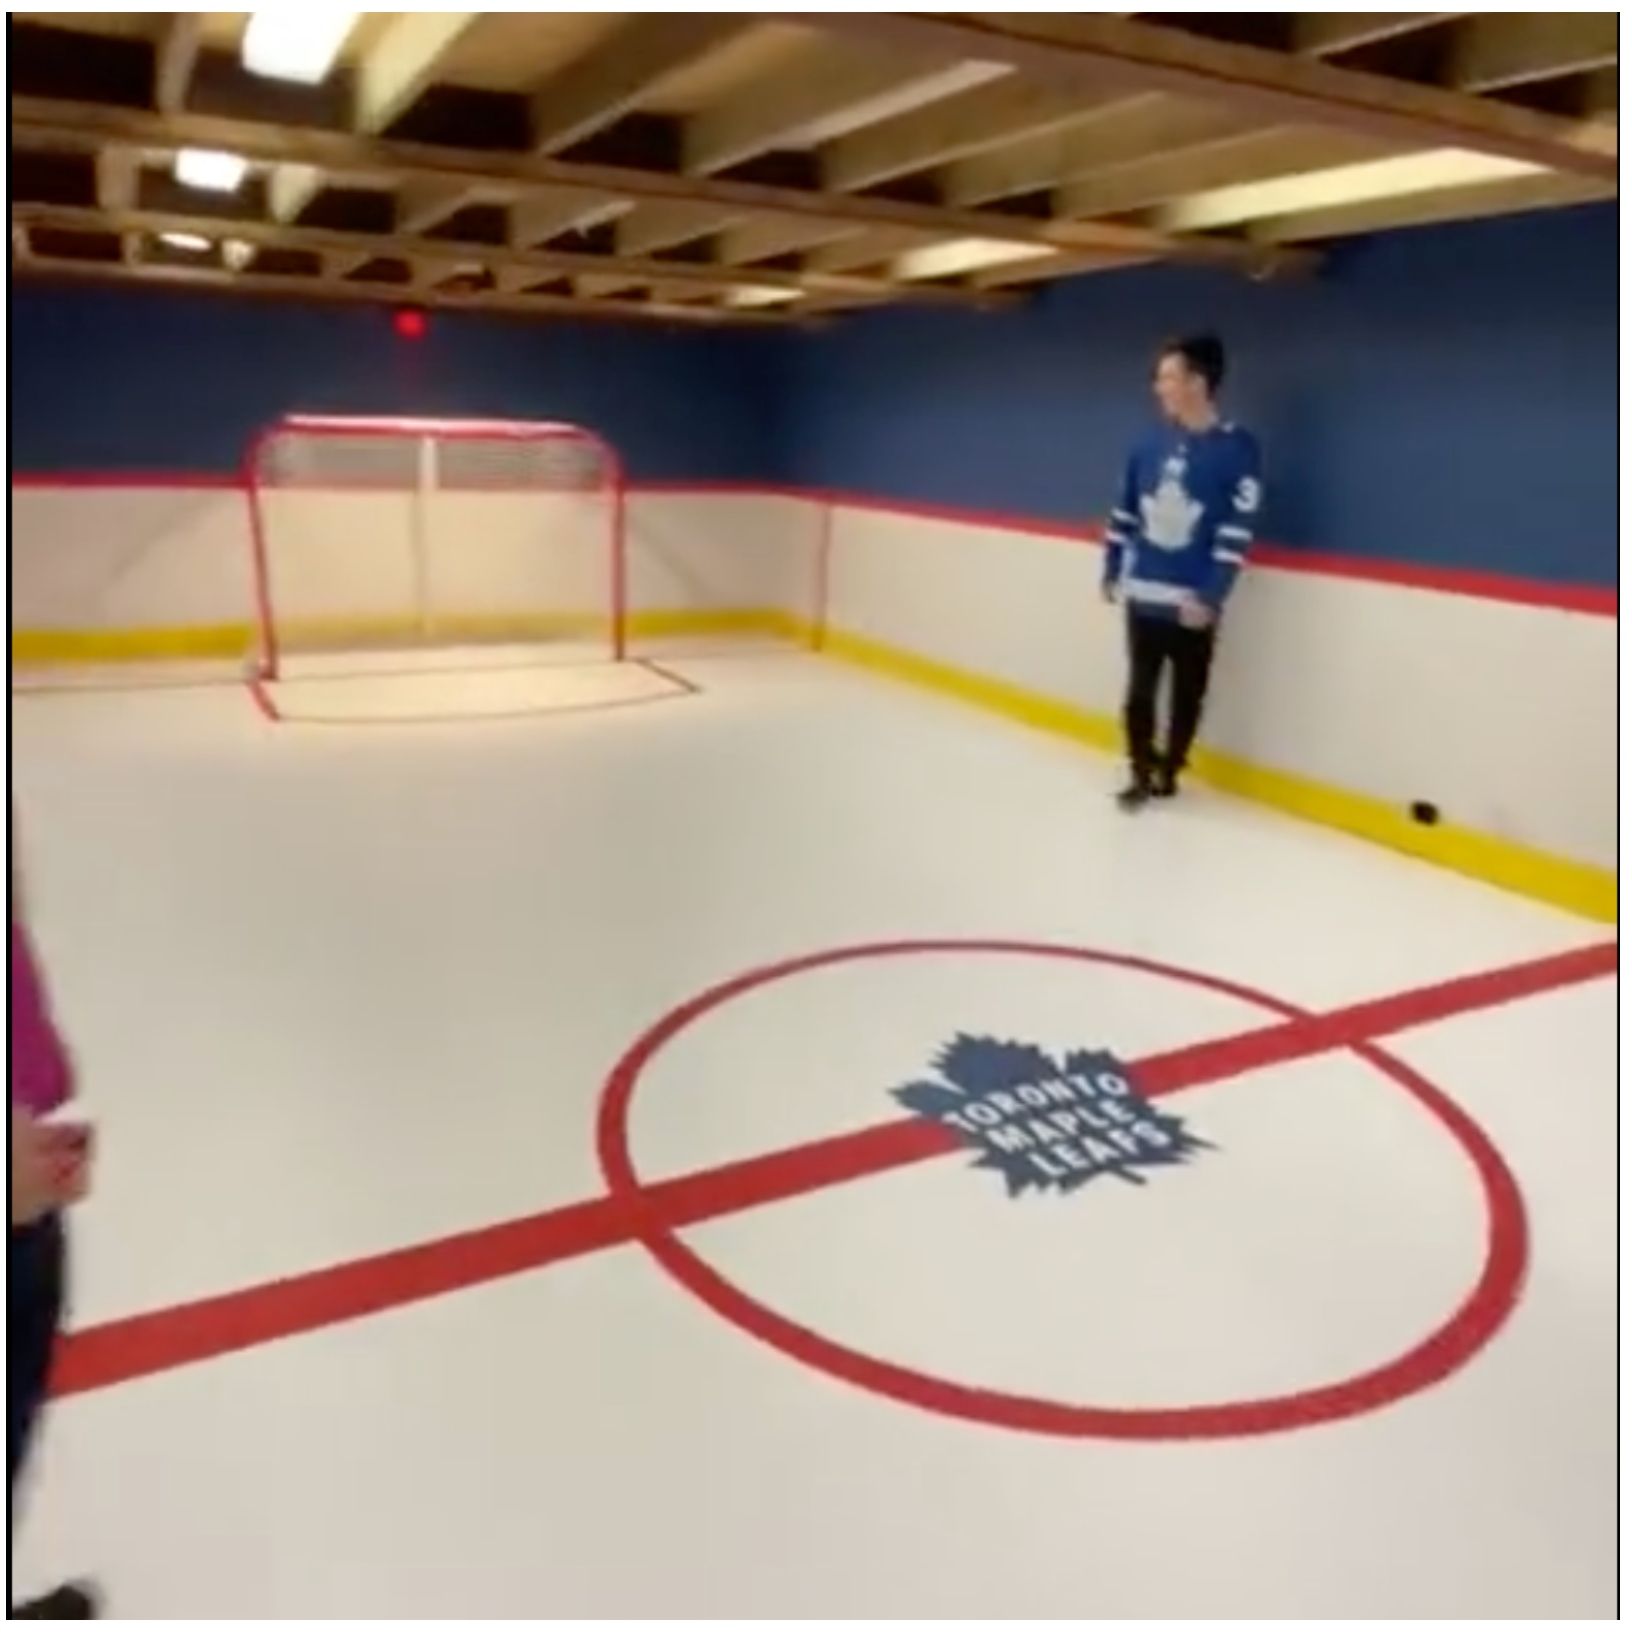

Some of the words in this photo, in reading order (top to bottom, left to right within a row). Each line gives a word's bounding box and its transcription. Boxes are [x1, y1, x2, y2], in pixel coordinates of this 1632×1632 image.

[941, 1071, 1130, 1132] TORONTO
[984, 1099, 1135, 1153] MAPLE
[1027, 1119, 1172, 1178] LEAFS
